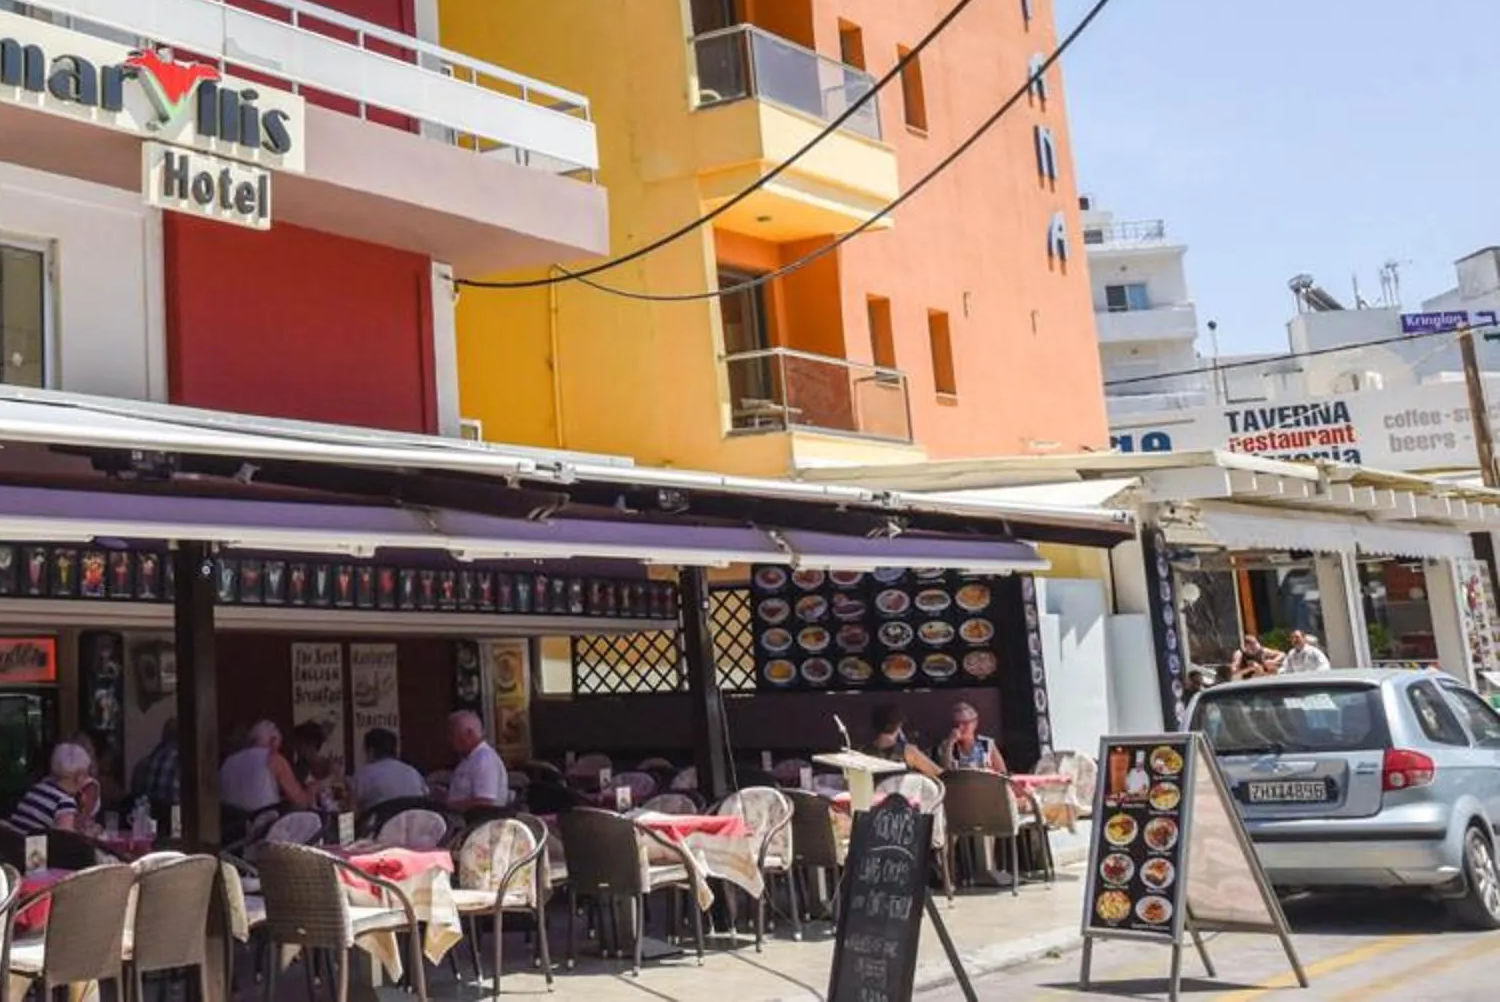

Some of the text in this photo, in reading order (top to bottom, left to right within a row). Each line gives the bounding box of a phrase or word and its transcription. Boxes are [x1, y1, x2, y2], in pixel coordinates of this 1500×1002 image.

[163, 151, 268, 220] Hotel
[1224, 401, 1351, 433] TAVERNA
[1383, 408, 1442, 429] coffee
[1228, 425, 1356, 454] restaurant
[1389, 432, 1456, 453] beers
